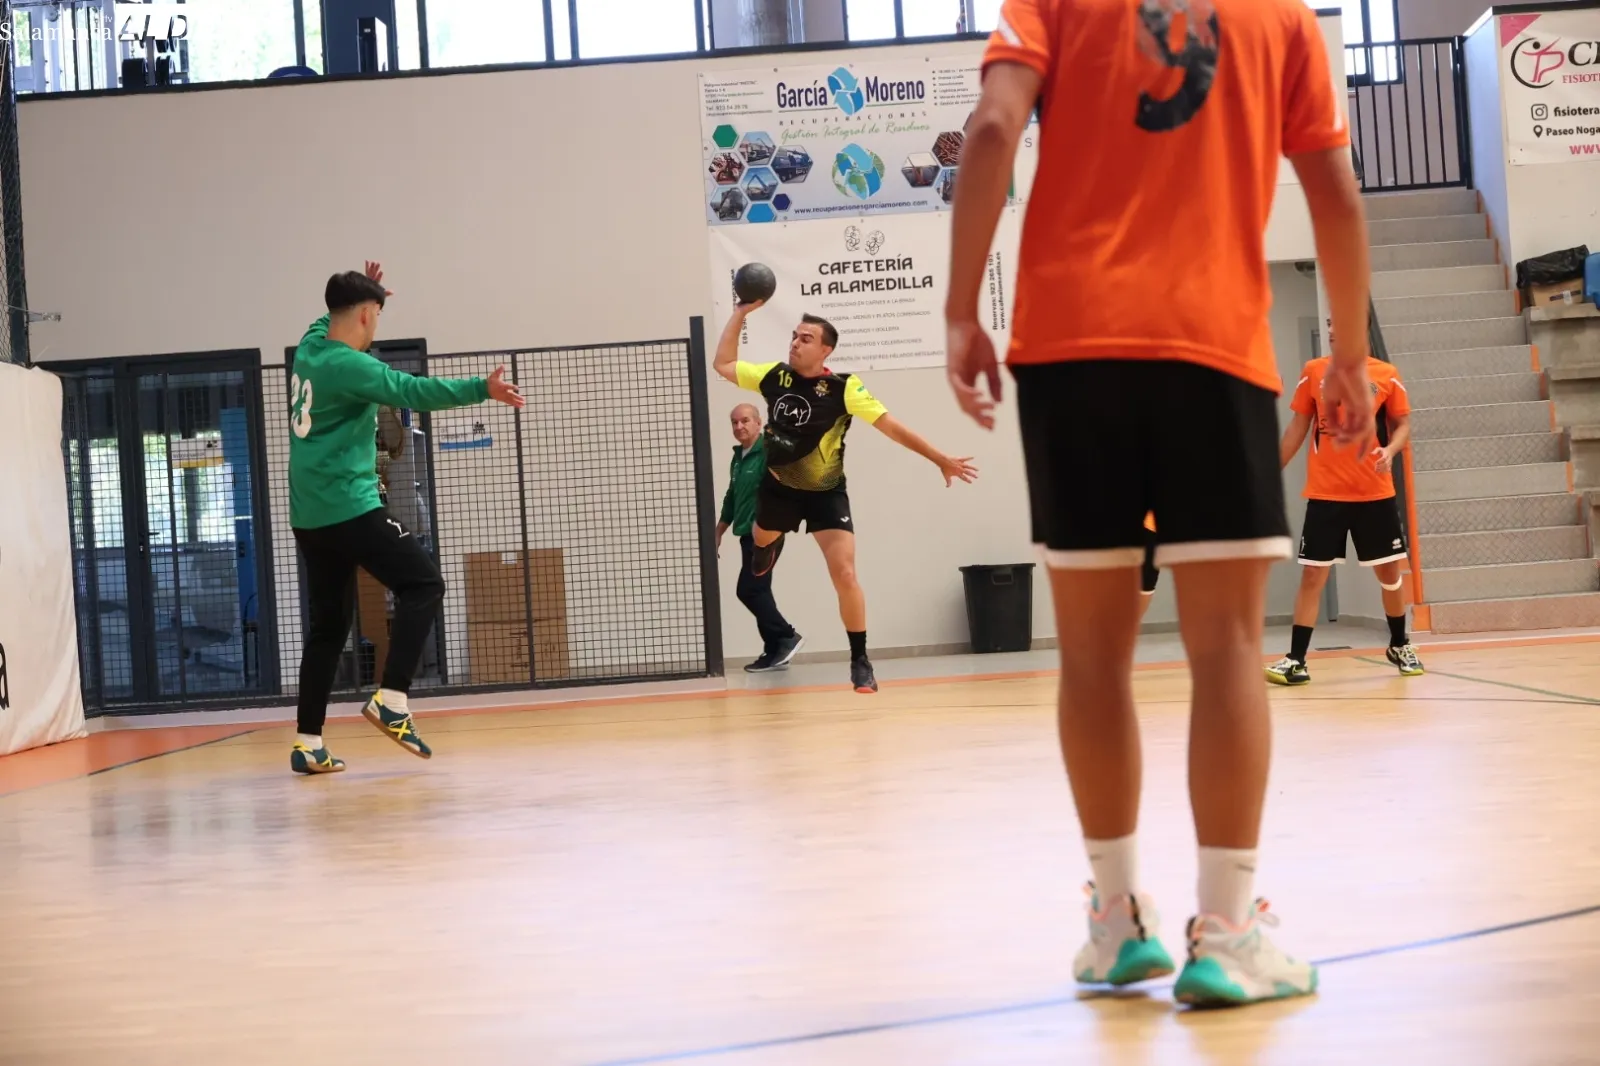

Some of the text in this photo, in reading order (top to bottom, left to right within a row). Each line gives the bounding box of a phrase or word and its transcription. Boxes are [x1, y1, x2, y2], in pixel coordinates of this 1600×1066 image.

[1135, 0, 1220, 132] 9
[777, 76, 925, 108] García Moreno
[868, 123, 880, 135] de
[1546, 127, 1574, 136] Paseo
[819, 254, 913, 275] CAFETERÍA
[801, 275, 933, 296] LA ALAMEDILLA
[778, 370, 793, 388] 16
[774, 402, 808, 425] PLAY
